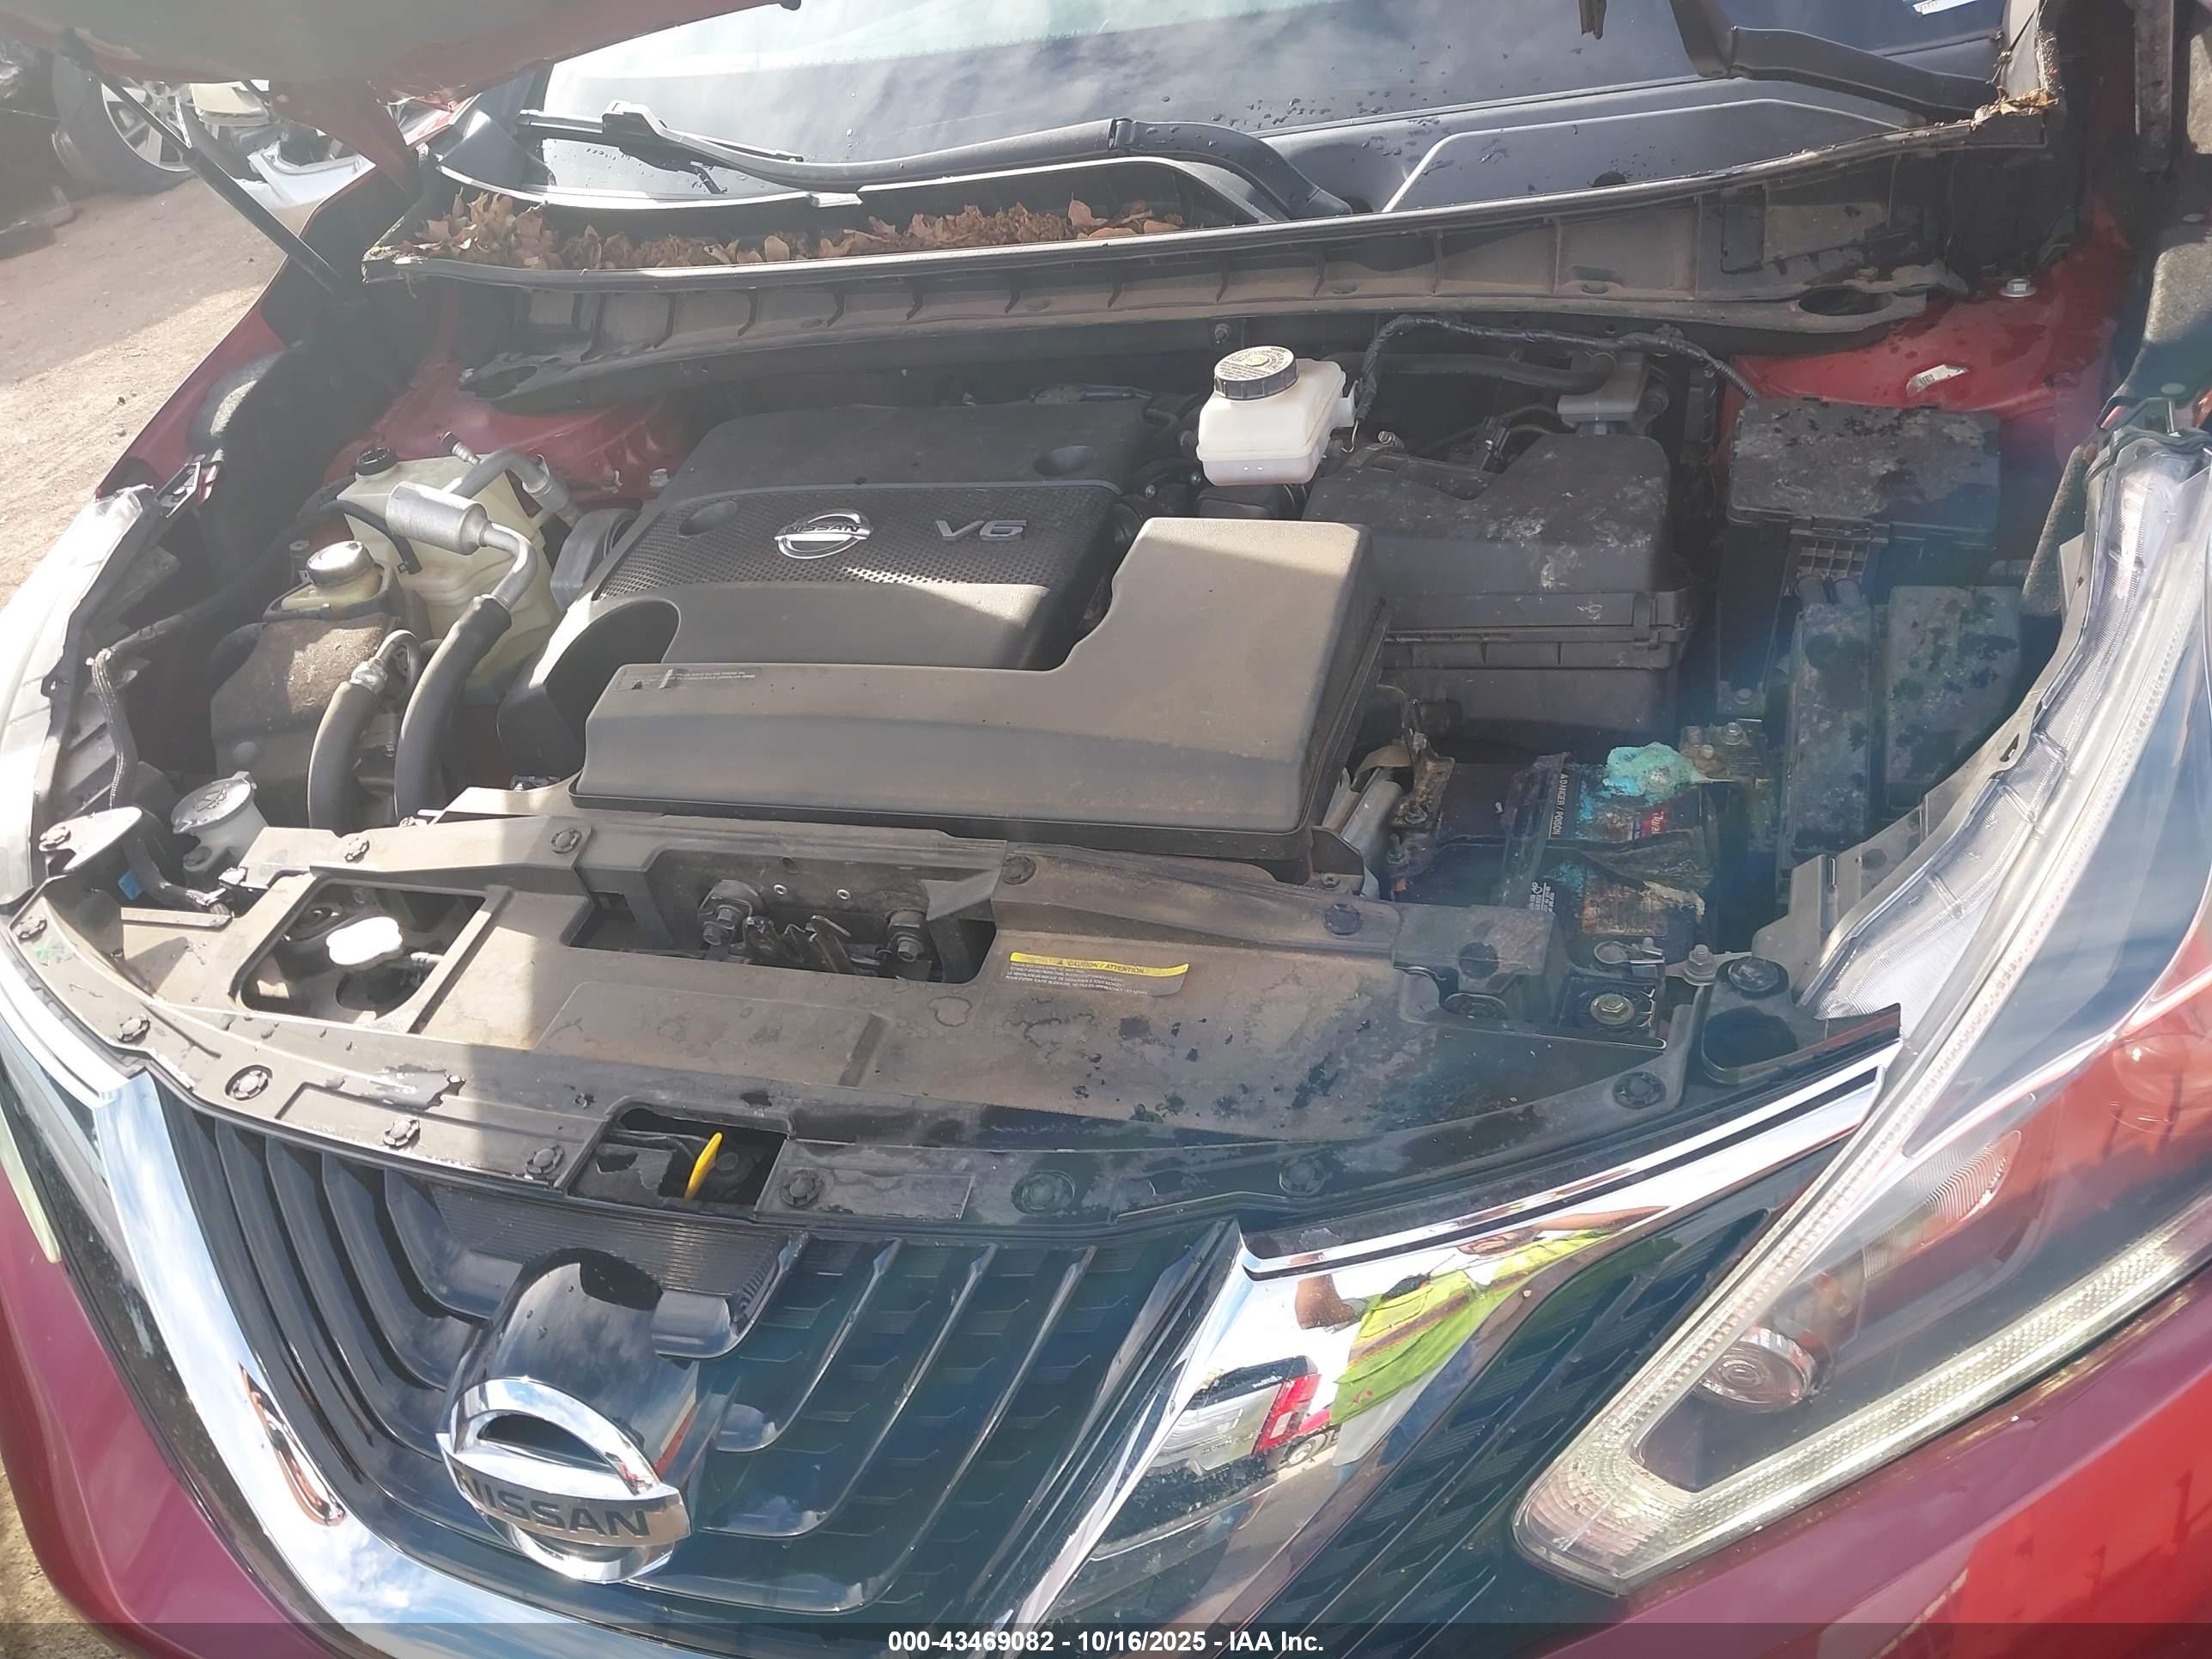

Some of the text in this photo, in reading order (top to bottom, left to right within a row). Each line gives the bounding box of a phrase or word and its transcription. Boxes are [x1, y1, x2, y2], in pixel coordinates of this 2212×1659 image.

[786, 522, 861, 533] NISSAN
[934, 520, 1028, 542] V6
[1552, 811, 1565, 836] POISON
[1067, 960, 1099, 969] CAUTION
[1104, 963, 1146, 974] ATTENTION
[451, 1464, 651, 1538] NISSAN
